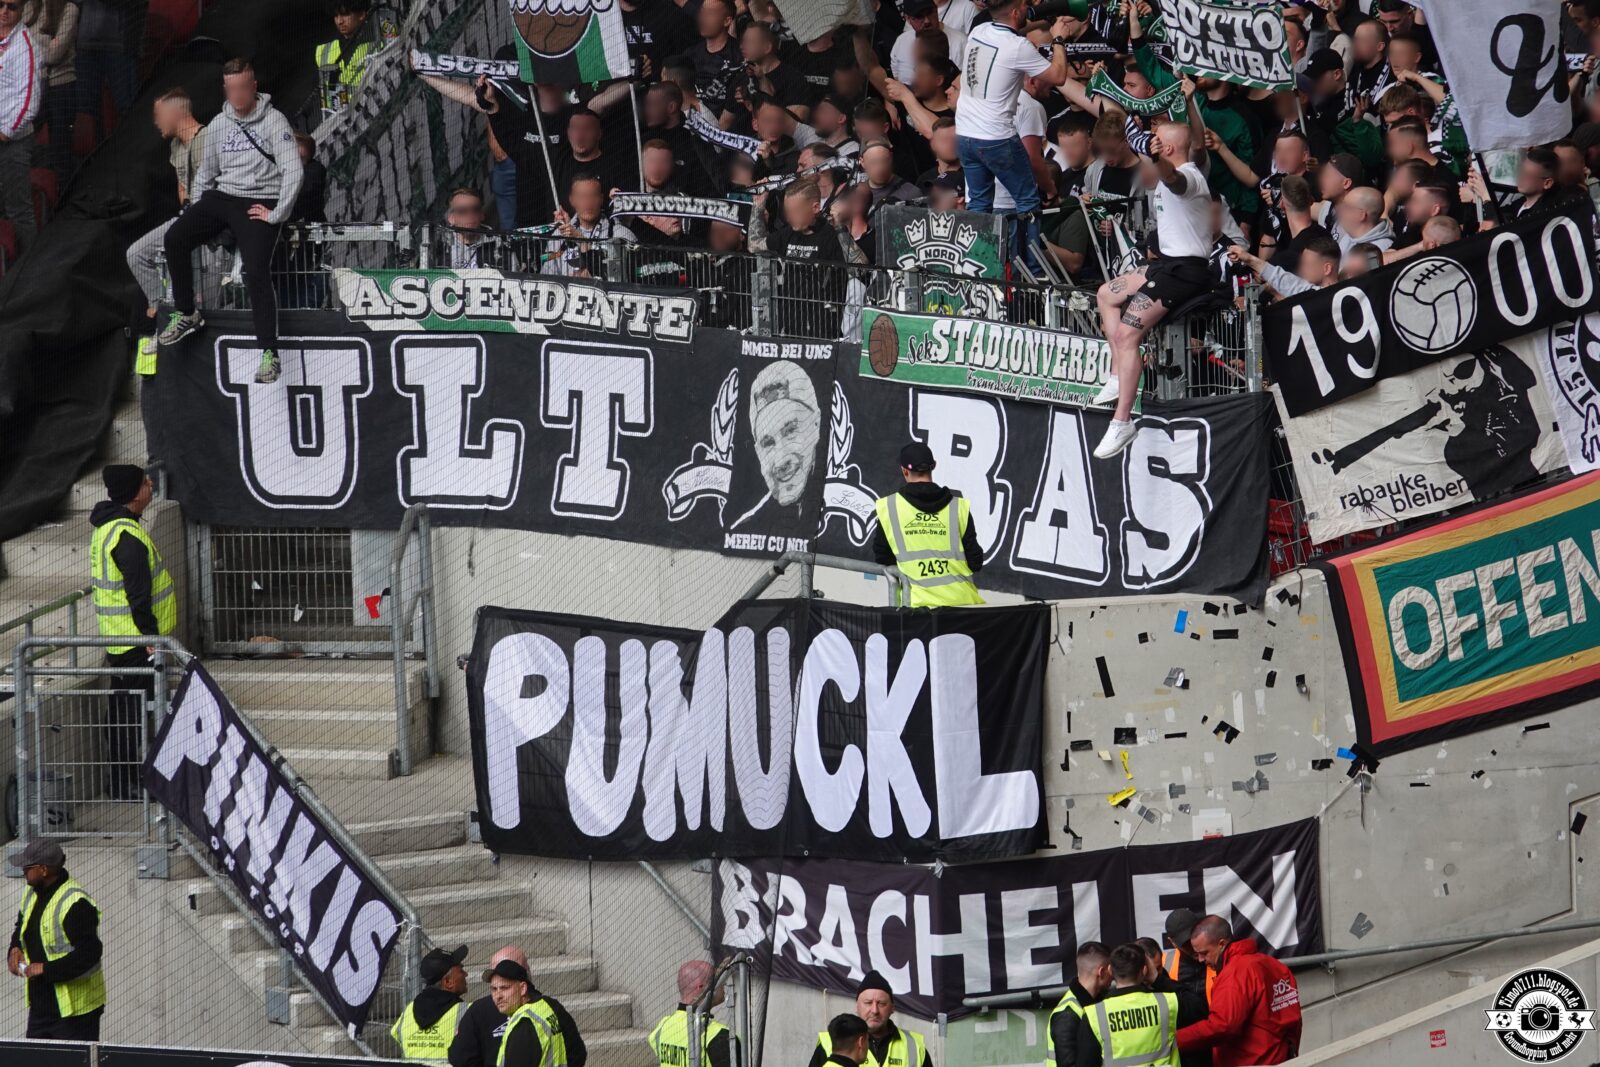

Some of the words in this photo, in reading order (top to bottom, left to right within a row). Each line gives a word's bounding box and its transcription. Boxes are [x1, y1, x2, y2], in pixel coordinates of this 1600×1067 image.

[971, 37, 999, 99] 7
[613, 195, 739, 220] SOTTOCULTURA
[924, 248, 956, 260] NORD
[346, 273, 697, 343] ASCENDENTE
[741, 340, 778, 358] IMMER
[780, 344, 803, 358] BEI
[805, 344, 833, 360] UNS
[1339, 473, 1427, 510] rabauke
[915, 512, 939, 522] SDS
[724, 533, 767, 551] MEREU
[767, 536, 785, 553] CU
[918, 560, 950, 577] 2437
[483, 626, 1040, 842] PUMUCKL
[153, 669, 402, 1007] PINKIS
[1108, 1004, 1159, 1033] SECURITY
